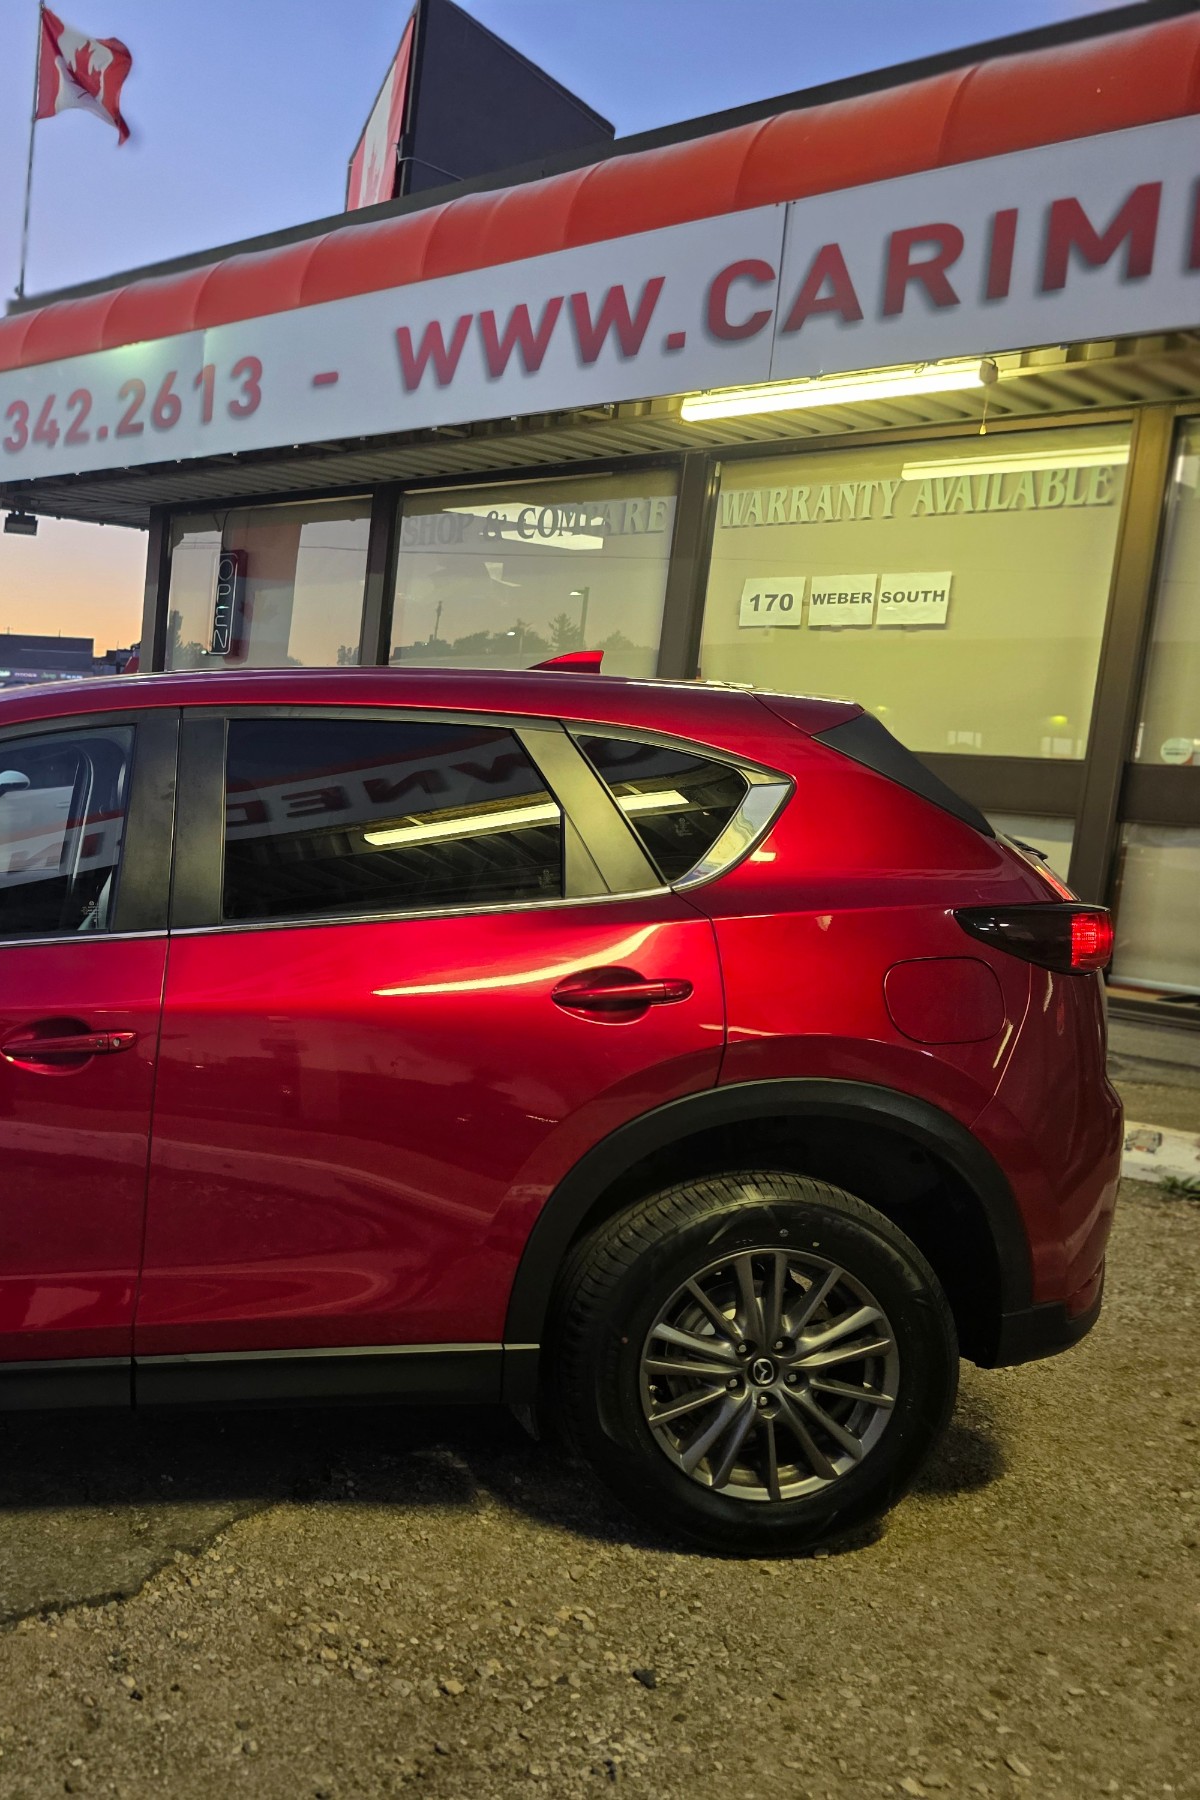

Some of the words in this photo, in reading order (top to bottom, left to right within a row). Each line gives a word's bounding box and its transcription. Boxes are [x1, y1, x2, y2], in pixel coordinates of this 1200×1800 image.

[397, 172, 1200, 392] WWW.CARIM
[402, 514, 474, 546] SHOP
[483, 510, 507, 542] &
[517, 501, 669, 540] COMPARE
[720, 480, 902, 529] WARRANTY
[910, 464, 1114, 517] AVAILABLE
[748, 593, 795, 613] 170
[812, 591, 873, 605] WEBER
[880, 589, 946, 604] SOUTH
